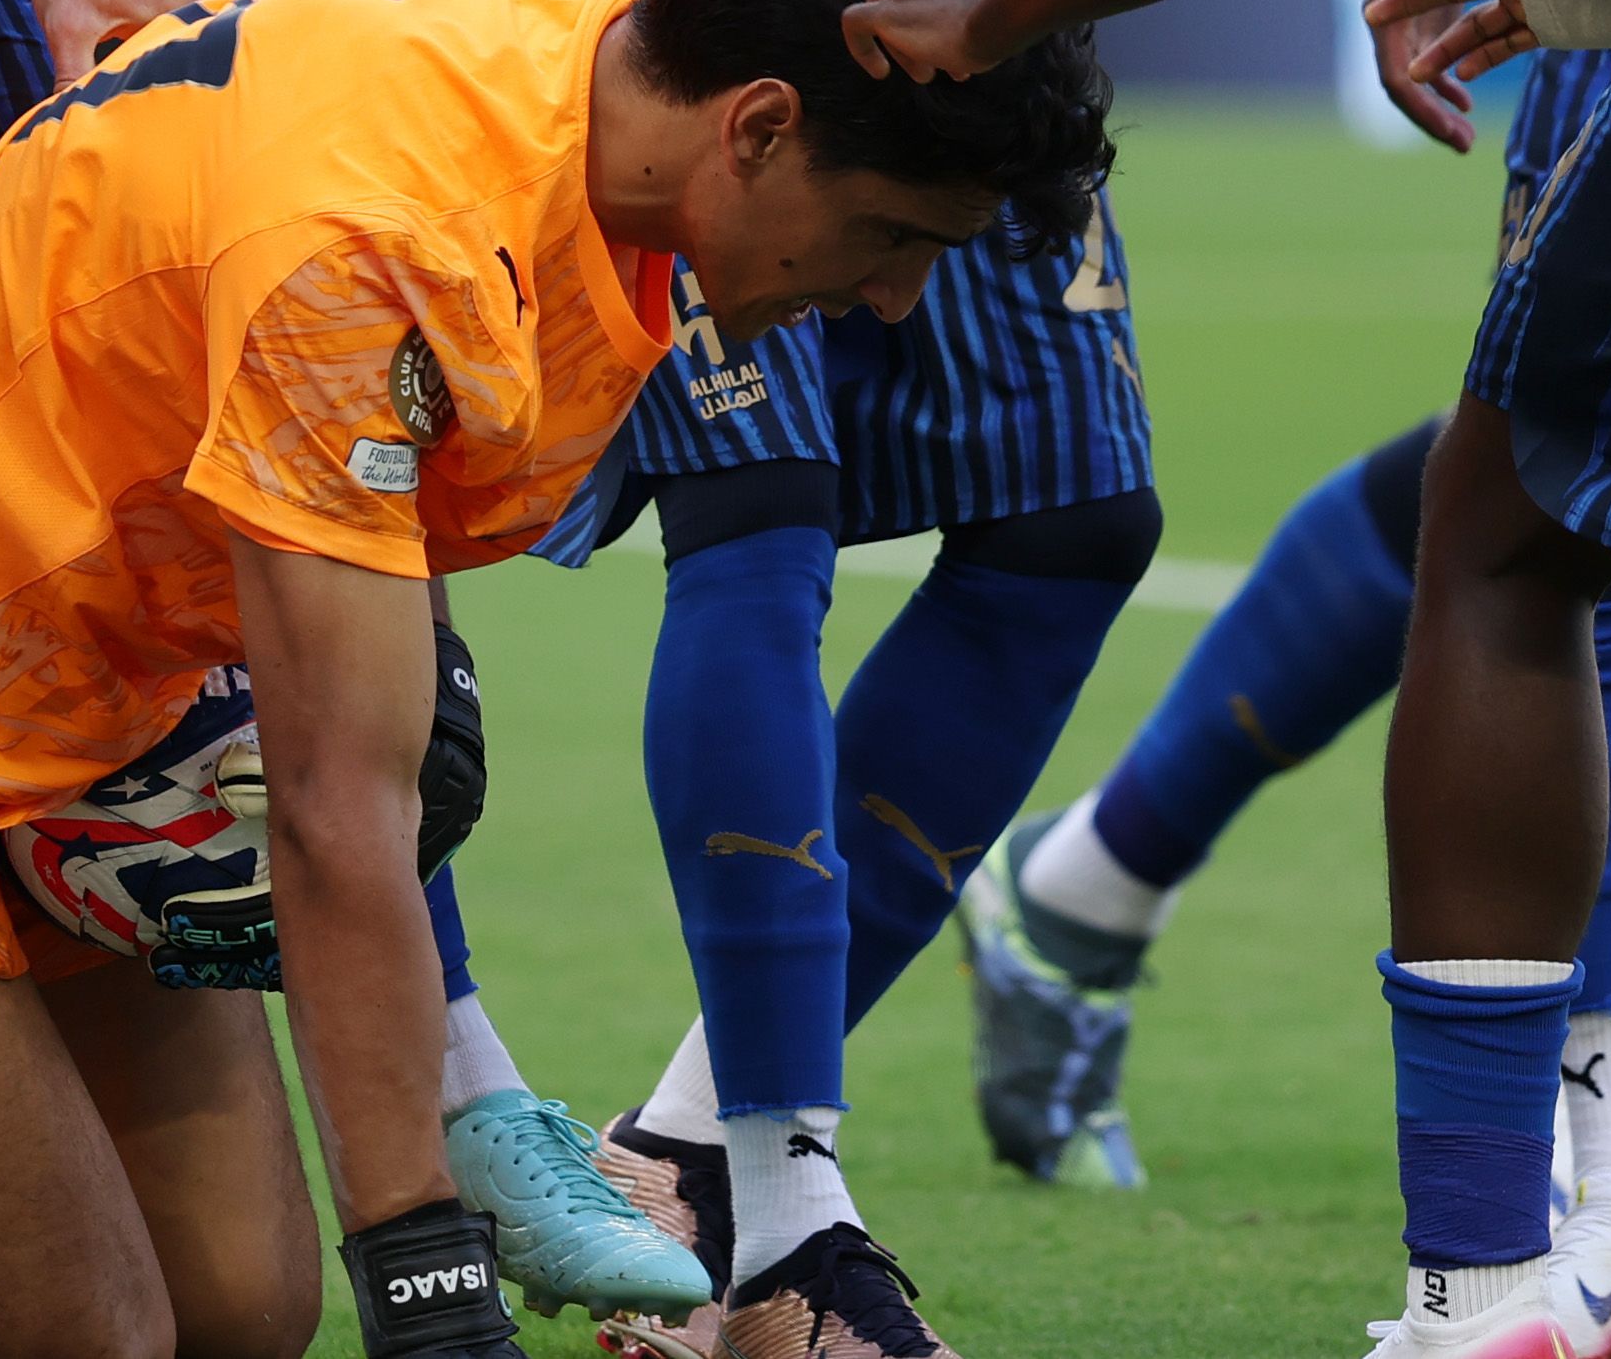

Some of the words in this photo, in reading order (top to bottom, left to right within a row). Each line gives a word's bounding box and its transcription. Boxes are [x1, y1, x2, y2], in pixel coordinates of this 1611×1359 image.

[399, 351, 414, 398] CLUB
[690, 362, 764, 400] ALHILAL
[699, 382, 768, 421] الهلال
[408, 404, 434, 435] FIFA
[368, 446, 409, 465] FOOTBALL
[361, 465, 384, 482] the
[183, 919, 277, 945] ELIT
[387, 1263, 488, 1304] ISAAC
